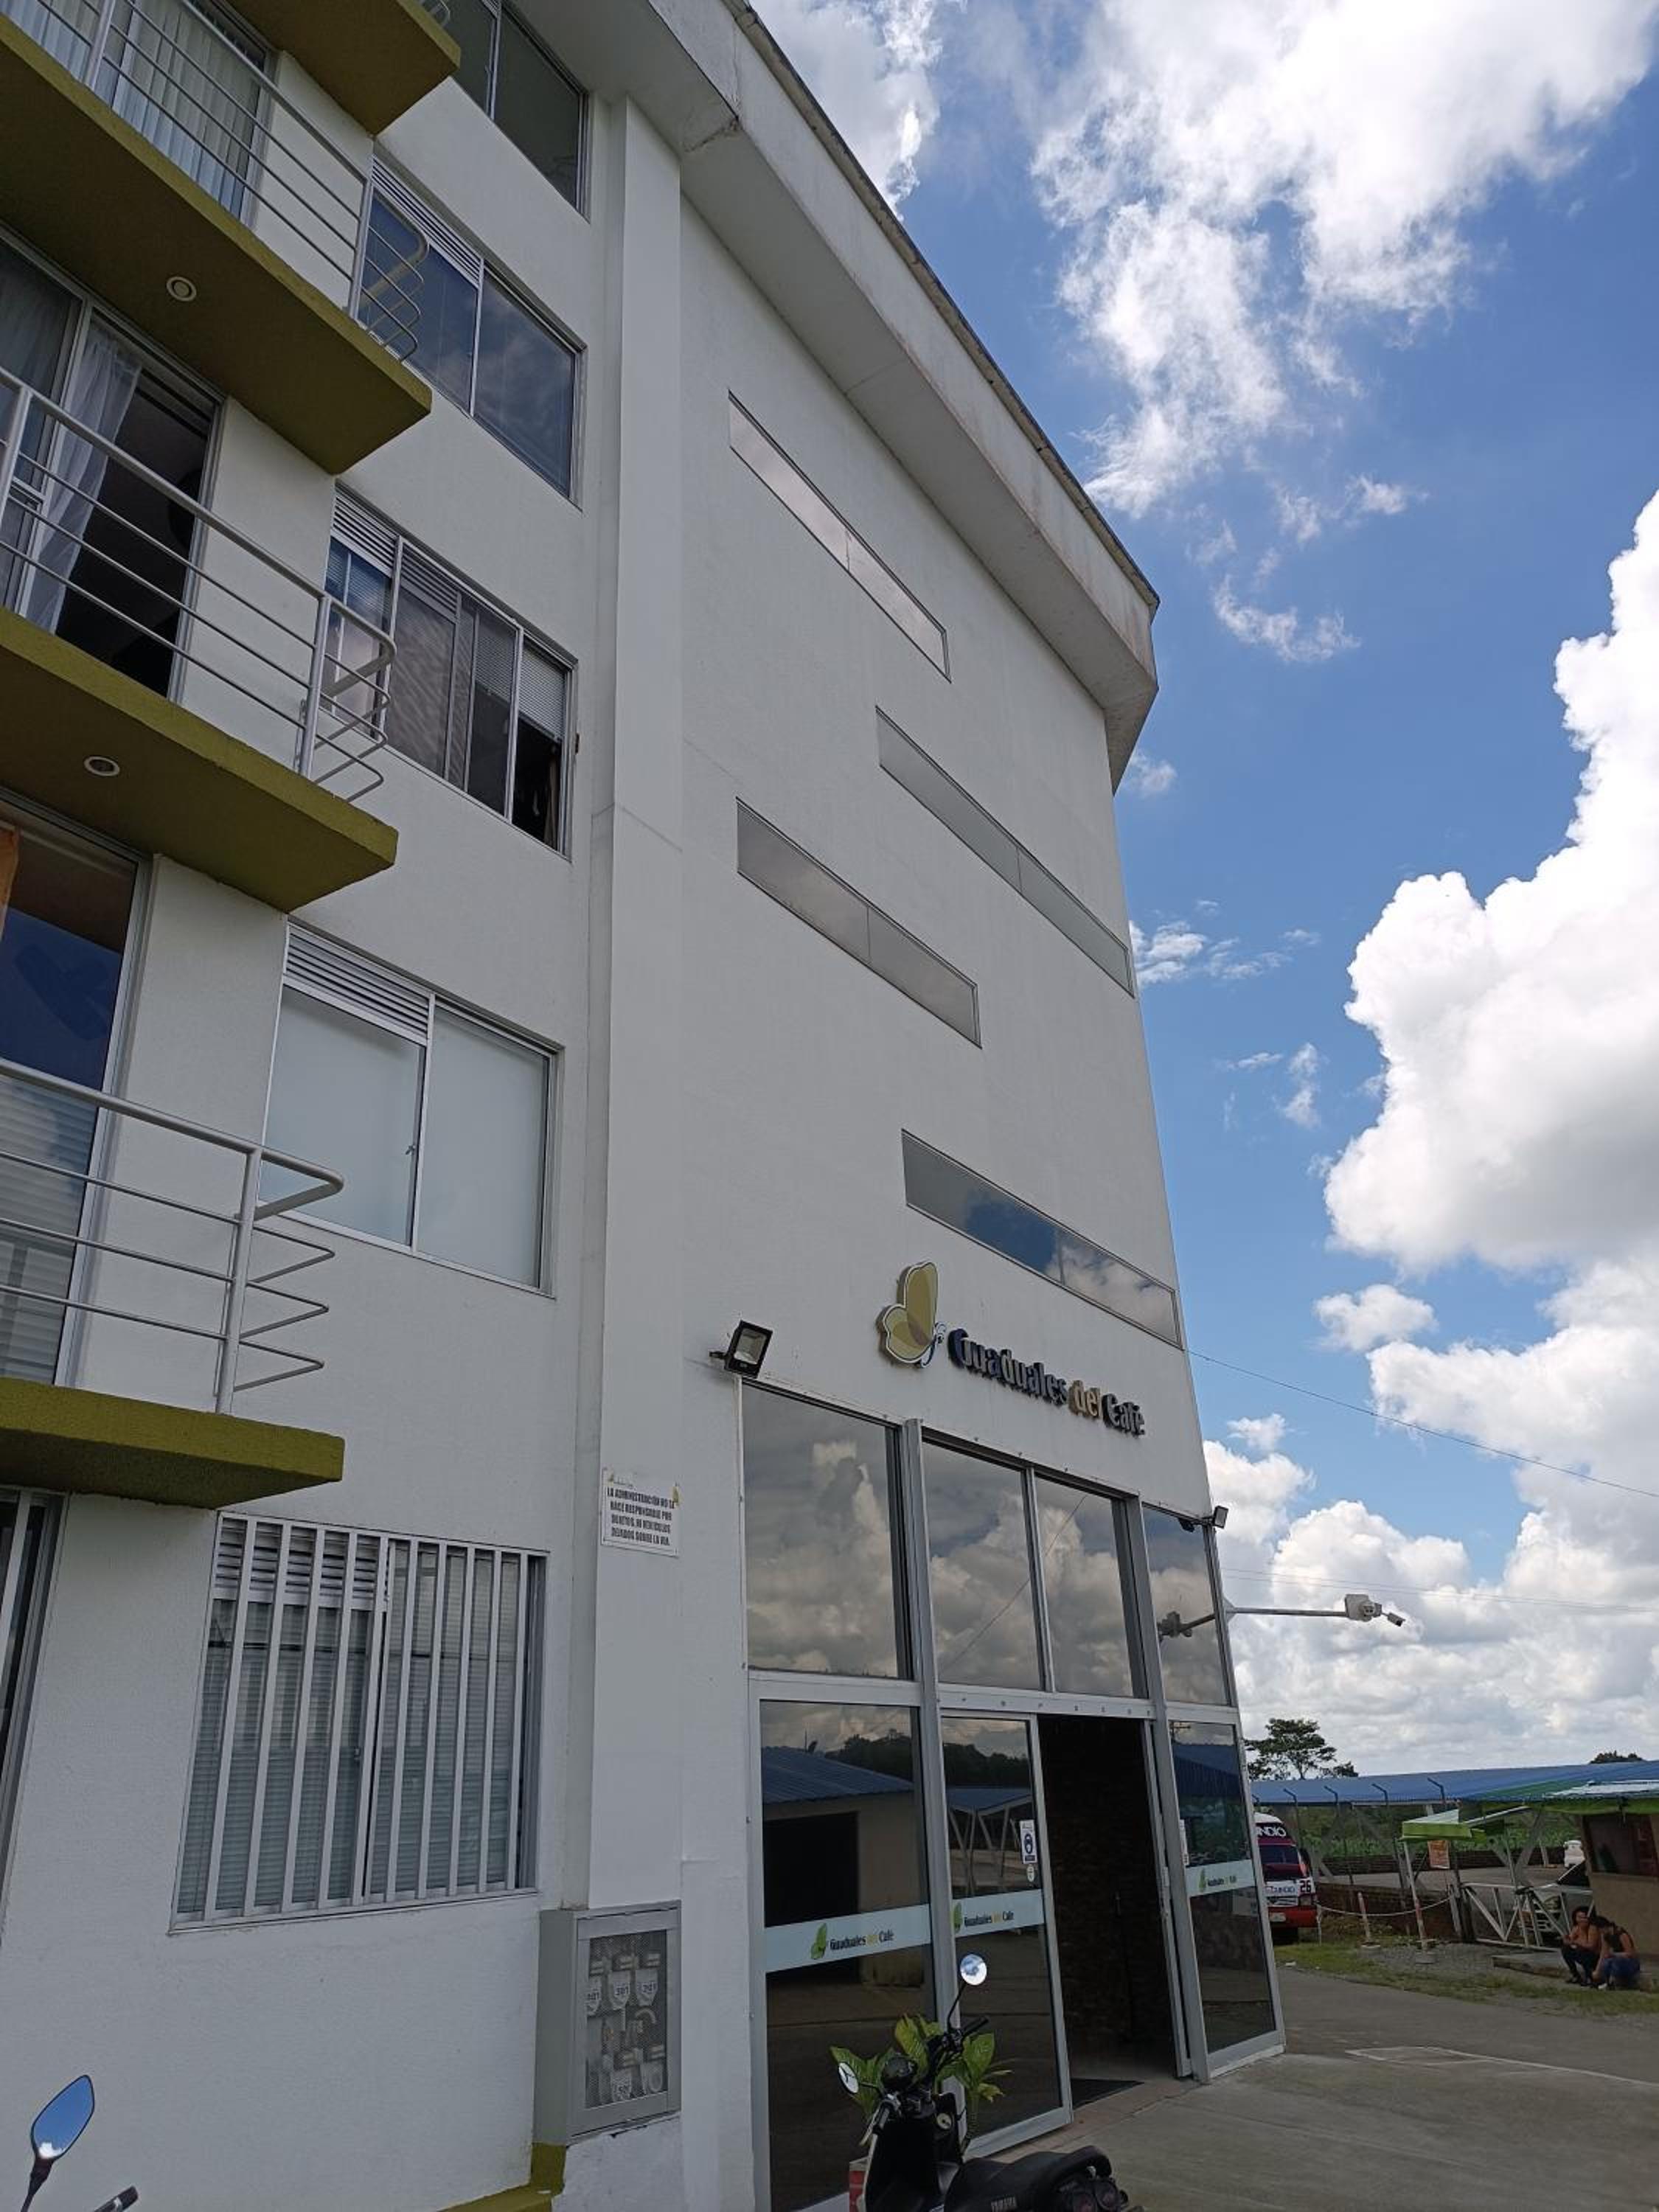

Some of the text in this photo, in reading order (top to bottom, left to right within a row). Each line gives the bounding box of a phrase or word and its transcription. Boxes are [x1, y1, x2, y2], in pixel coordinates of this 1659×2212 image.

[947, 1329, 1145, 1435] Guaduales del Café
[608, 1487, 613, 1497] LA
[661, 1498, 668, 1508] NO
[611, 1501, 624, 1512] HACE
[662, 1511, 672, 1521] POR
[653, 1534, 659, 1544] LA
[1300, 1880, 1311, 1892] 26
